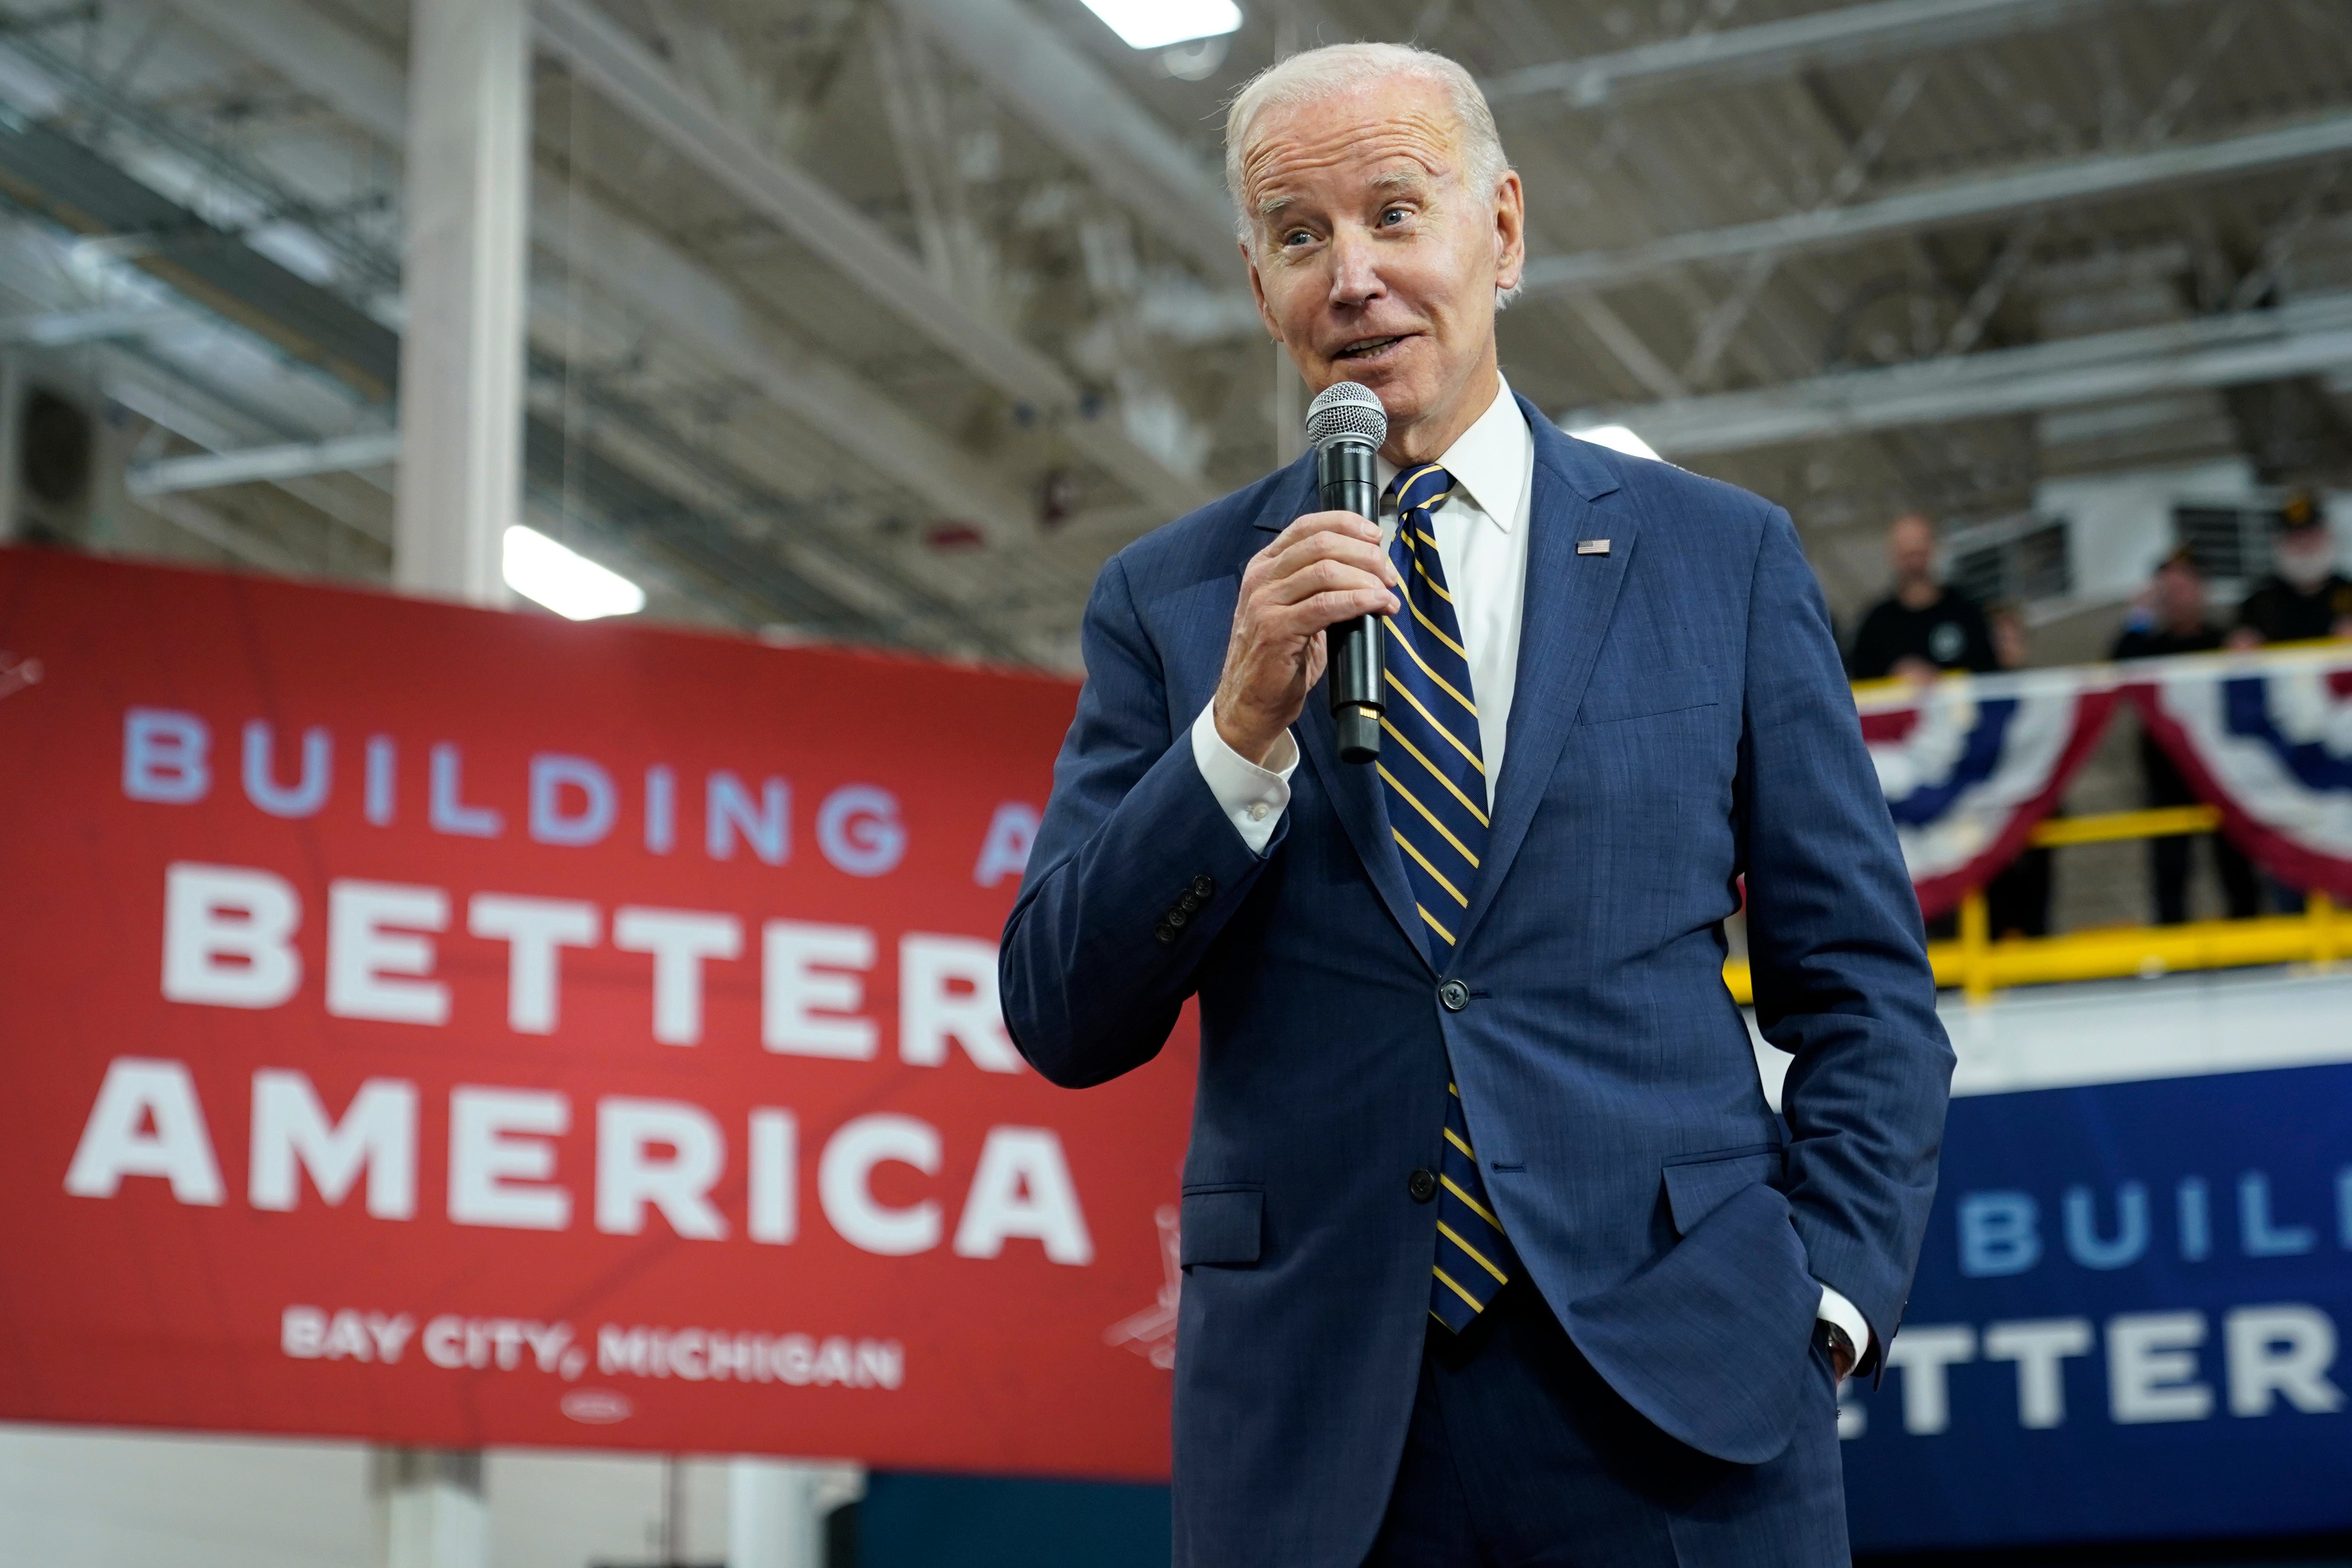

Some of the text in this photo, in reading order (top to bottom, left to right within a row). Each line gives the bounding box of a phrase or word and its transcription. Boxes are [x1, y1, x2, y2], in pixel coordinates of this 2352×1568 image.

[1343, 448, 1371, 456] SHURE
[122, 709, 908, 879] BUILDING
[162, 863, 1025, 1074] BETTER
[64, 1058, 1093, 1265] AMERICA
[1958, 1167, 2352, 1276] BUIL
[281, 1305, 904, 1390] BAY CITY, MICHIGAN
[1838, 1305, 2345, 1438] TTER
